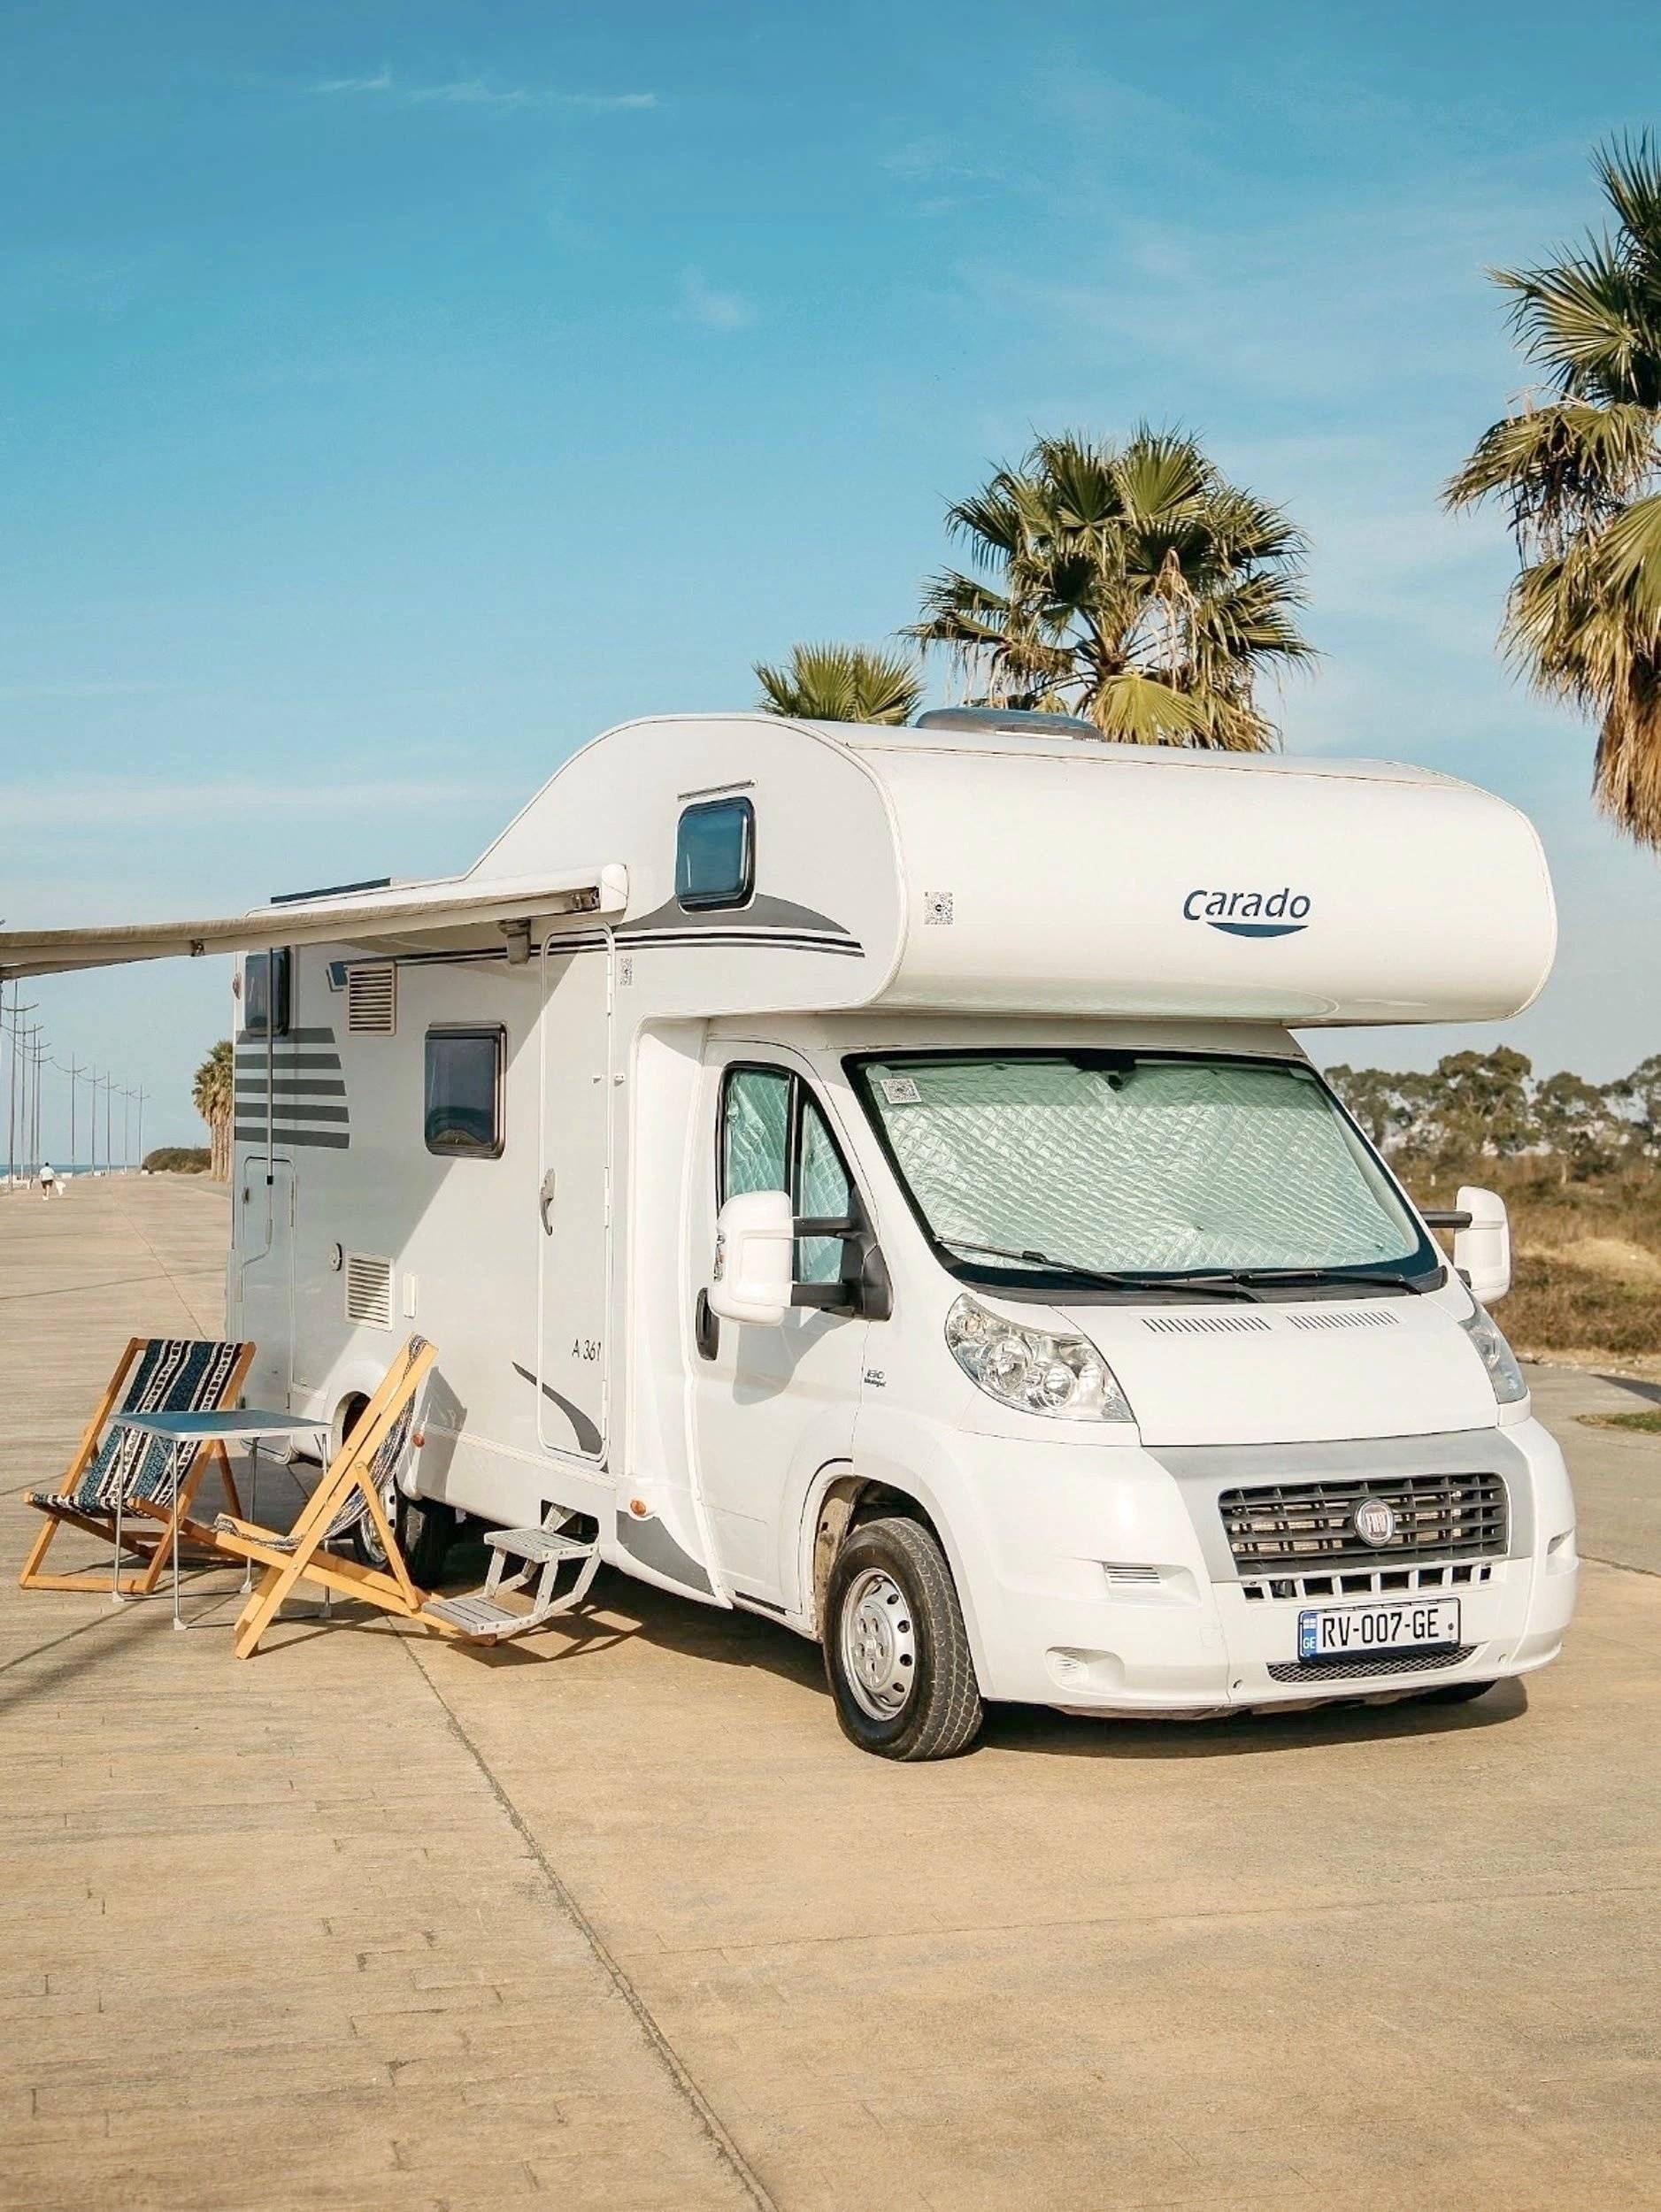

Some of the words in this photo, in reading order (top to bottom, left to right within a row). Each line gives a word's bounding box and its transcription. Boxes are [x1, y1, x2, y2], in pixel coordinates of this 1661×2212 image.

[1183, 887, 1311, 921] Carado
[572, 1339, 581, 1358] A
[583, 1339, 602, 1362] 361
[1322, 1608, 1440, 1648] RV-007-GE
[1303, 1637, 1317, 1650] GE
